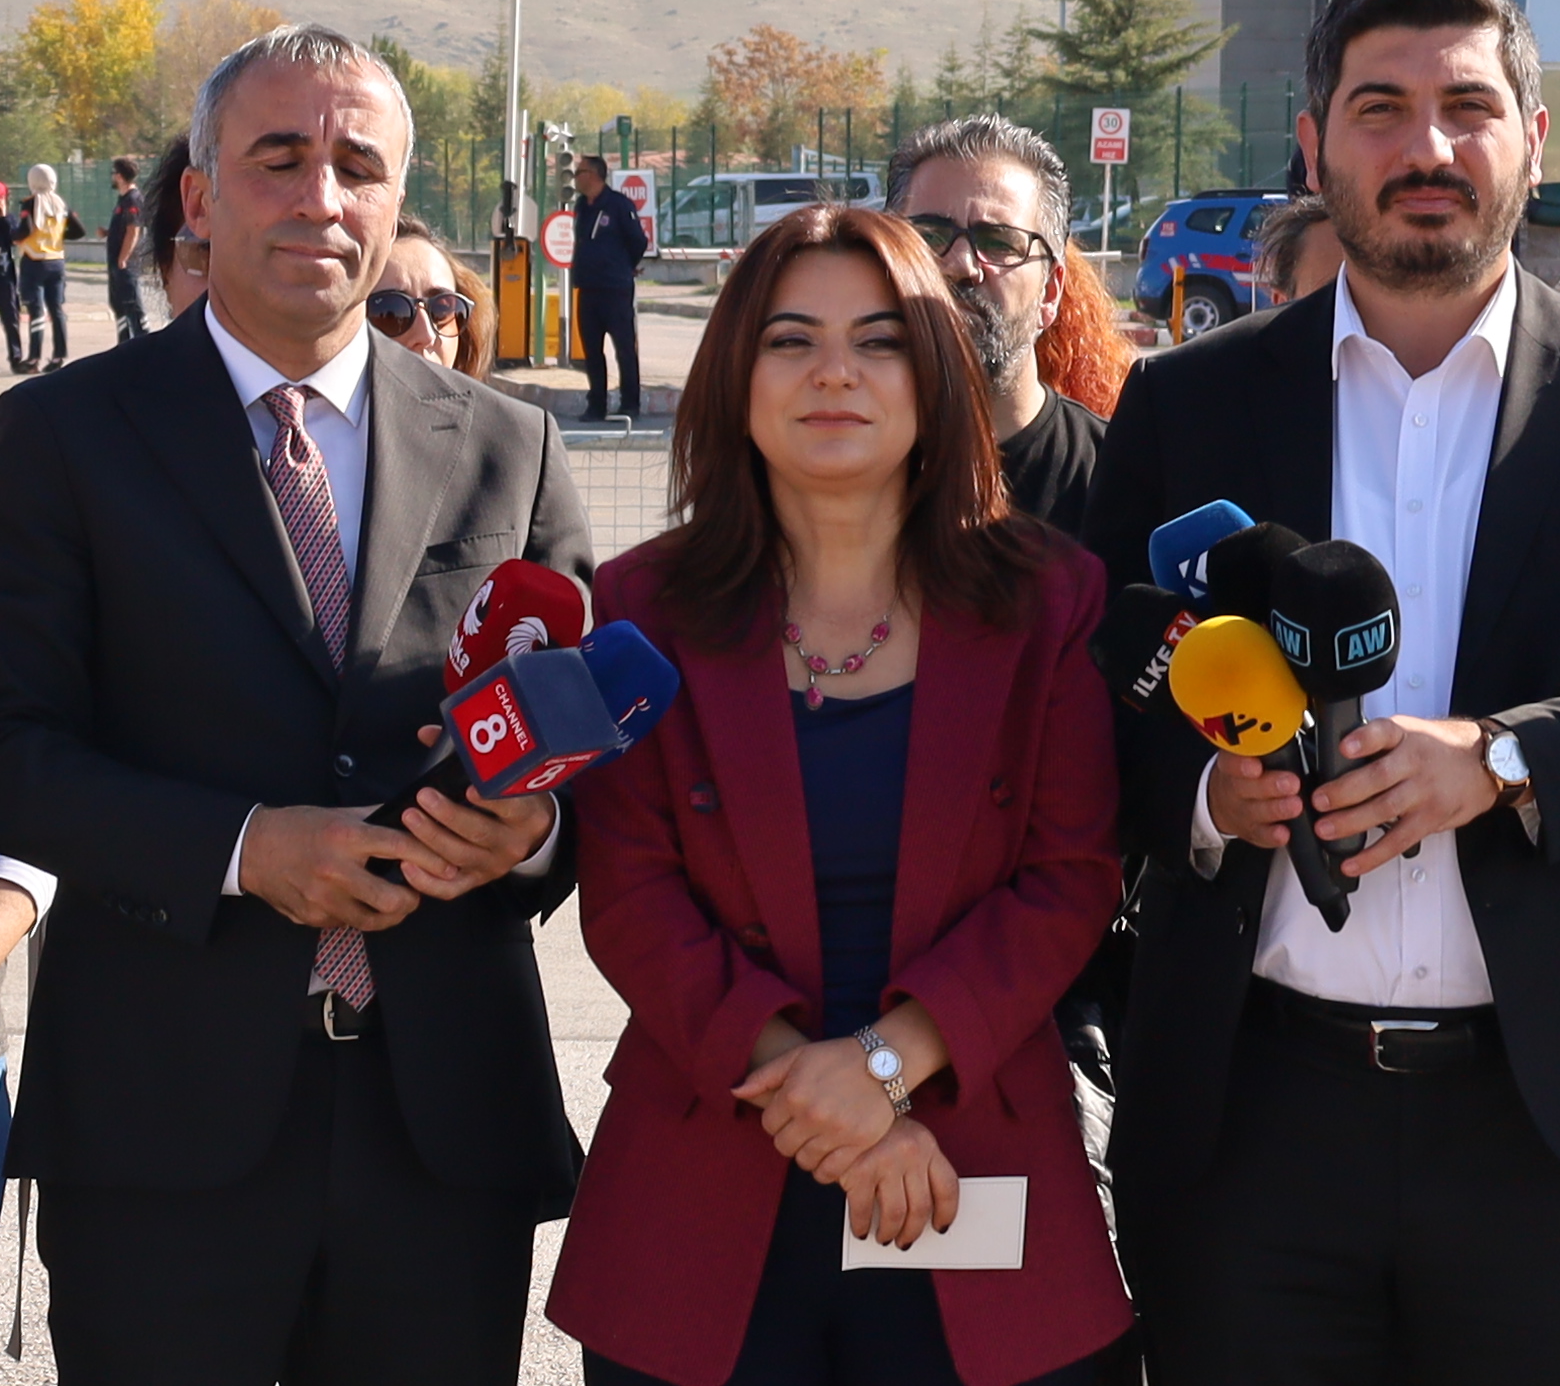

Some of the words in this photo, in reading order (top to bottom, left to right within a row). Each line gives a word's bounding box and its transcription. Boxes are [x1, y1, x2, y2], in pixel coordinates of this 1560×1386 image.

[1103, 117, 1118, 128] 30
[1347, 622, 1386, 661] AW
[469, 713, 508, 754] 8
[495, 683, 529, 751] CHANNEL
[525, 763, 567, 790] 8
